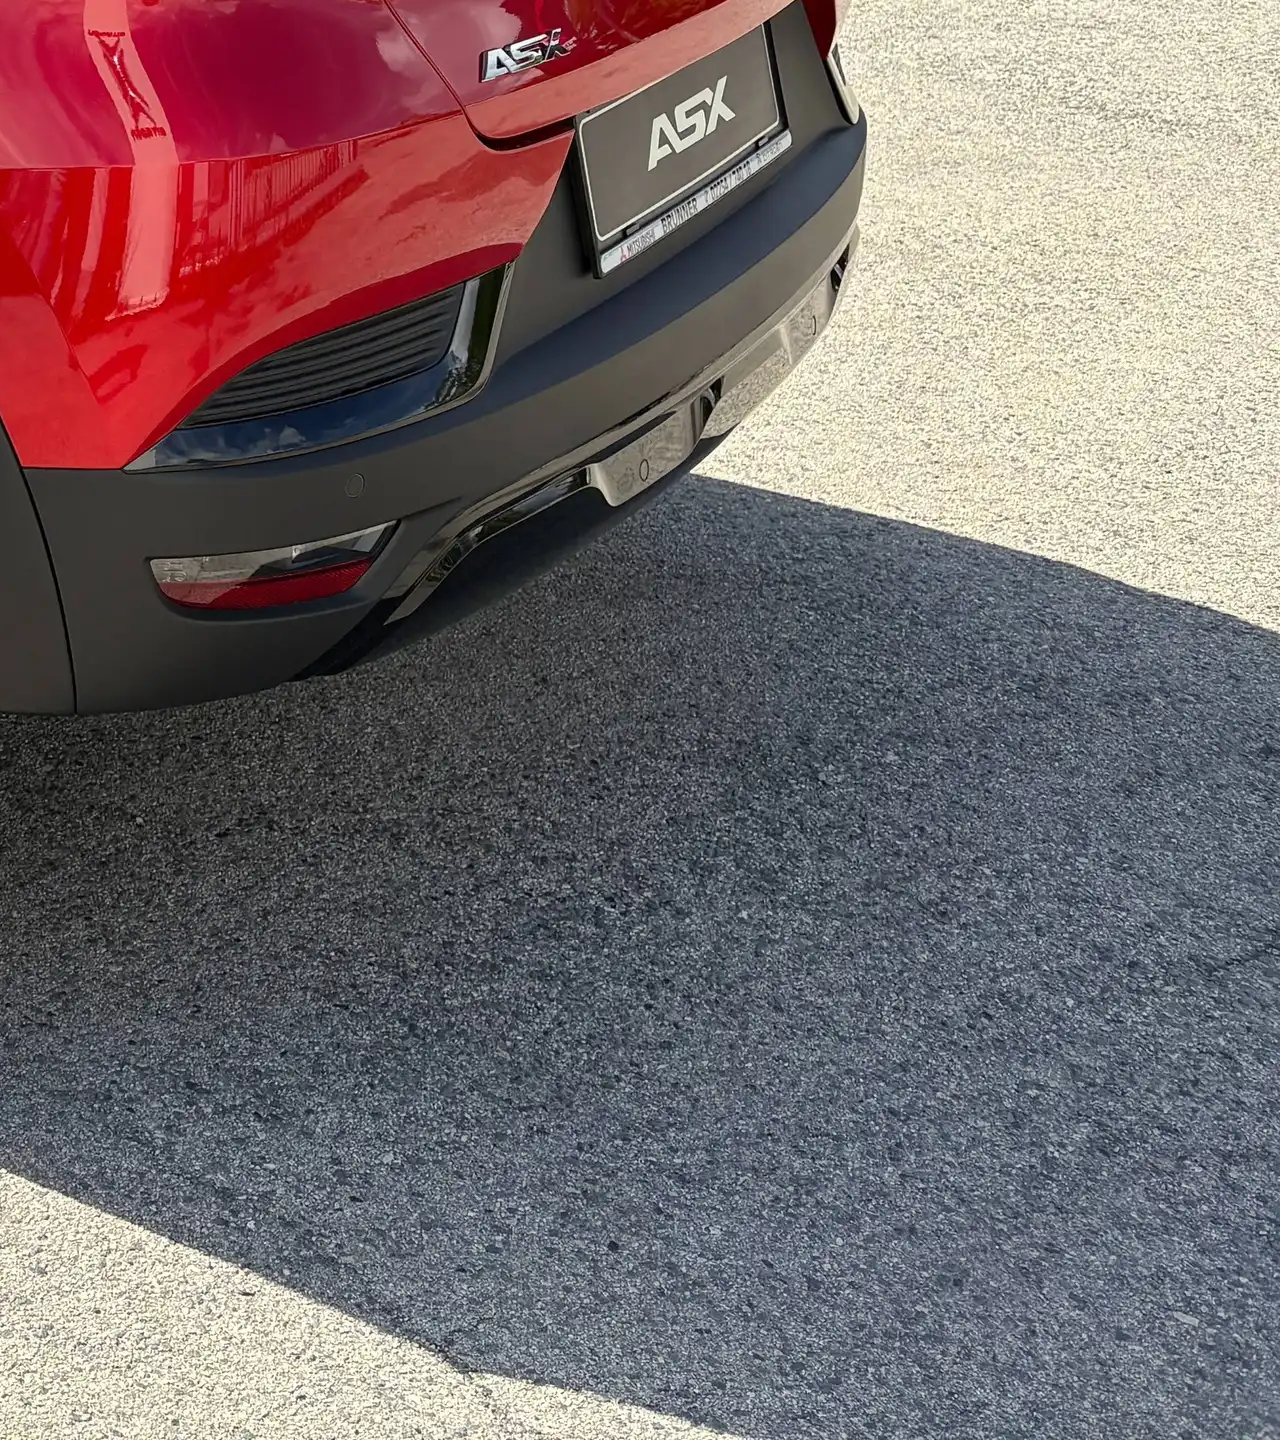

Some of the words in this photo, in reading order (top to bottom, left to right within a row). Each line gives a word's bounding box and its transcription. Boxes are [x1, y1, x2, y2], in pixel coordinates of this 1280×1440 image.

[479, 28, 572, 83] ASX
[647, 75, 736, 172] ASX
[661, 197, 699, 235] BRUNNER
